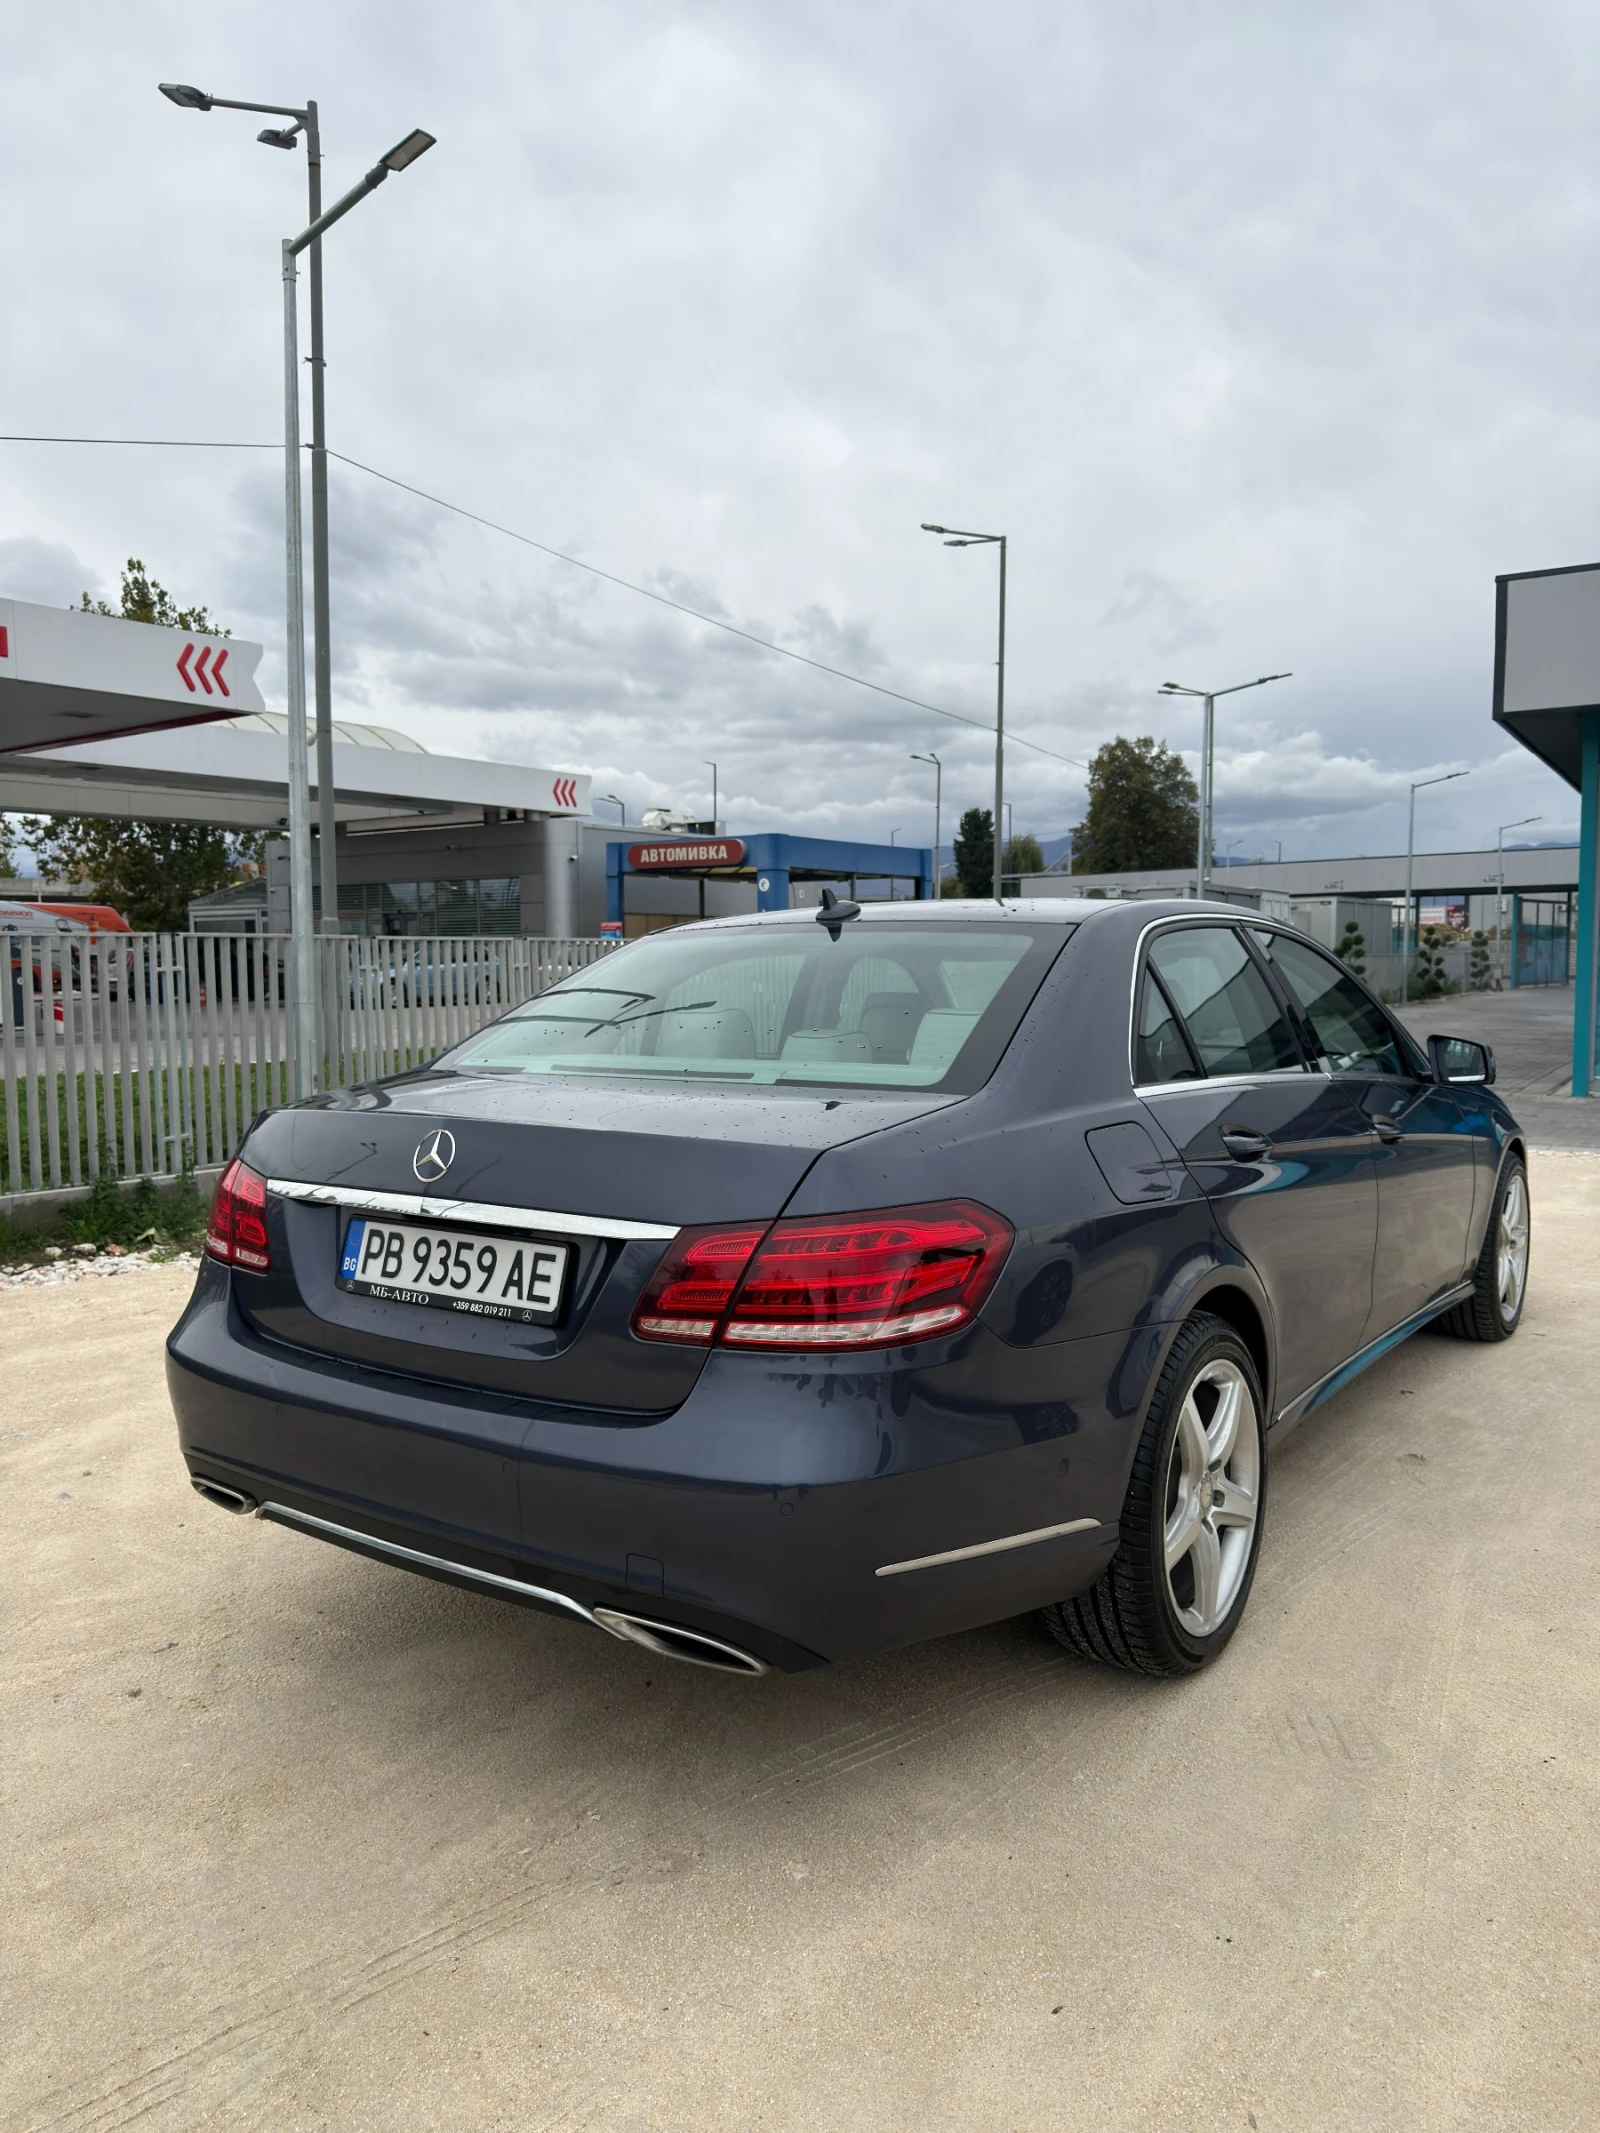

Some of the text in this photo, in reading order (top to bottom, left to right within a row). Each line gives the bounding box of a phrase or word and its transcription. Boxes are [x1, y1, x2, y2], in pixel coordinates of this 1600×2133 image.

[640, 845, 728, 863] АВТОМИВКА
[343, 1257, 357, 1272] BG
[361, 1228, 557, 1305] PB 9359 AE
[369, 1284, 429, 1305] МБ-АВТО
[452, 1301, 512, 1317] +359 882 019 211
